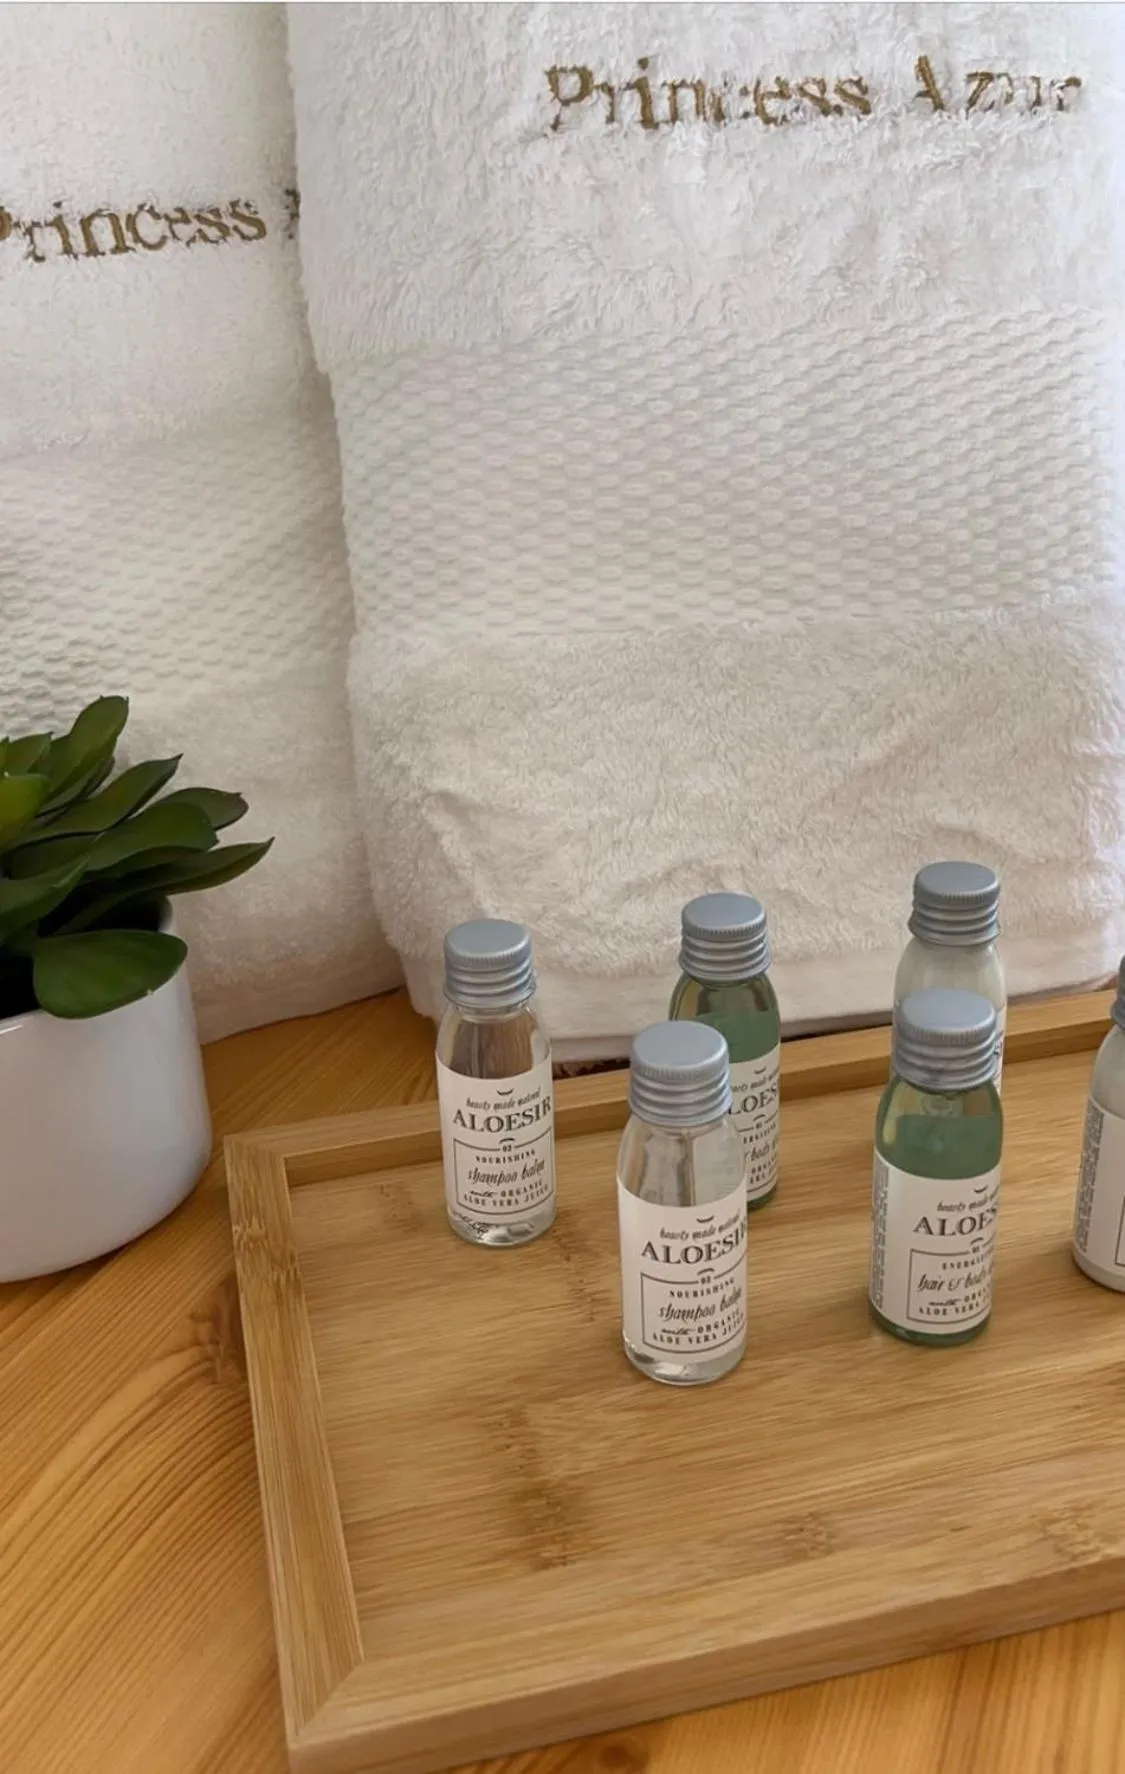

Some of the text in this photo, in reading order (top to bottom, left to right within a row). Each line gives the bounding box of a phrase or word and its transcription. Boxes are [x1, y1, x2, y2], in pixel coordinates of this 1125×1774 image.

[547, 57, 872, 131] Princess
[452, 1096, 551, 1133] ALOESIR
[475, 1149, 536, 1164] NOURISHING
[467, 1167, 518, 1186] shampoo
[669, 1277, 734, 1298] NOURISHING
[917, 1273, 945, 1292] hair
[658, 1302, 716, 1324] shampoo
